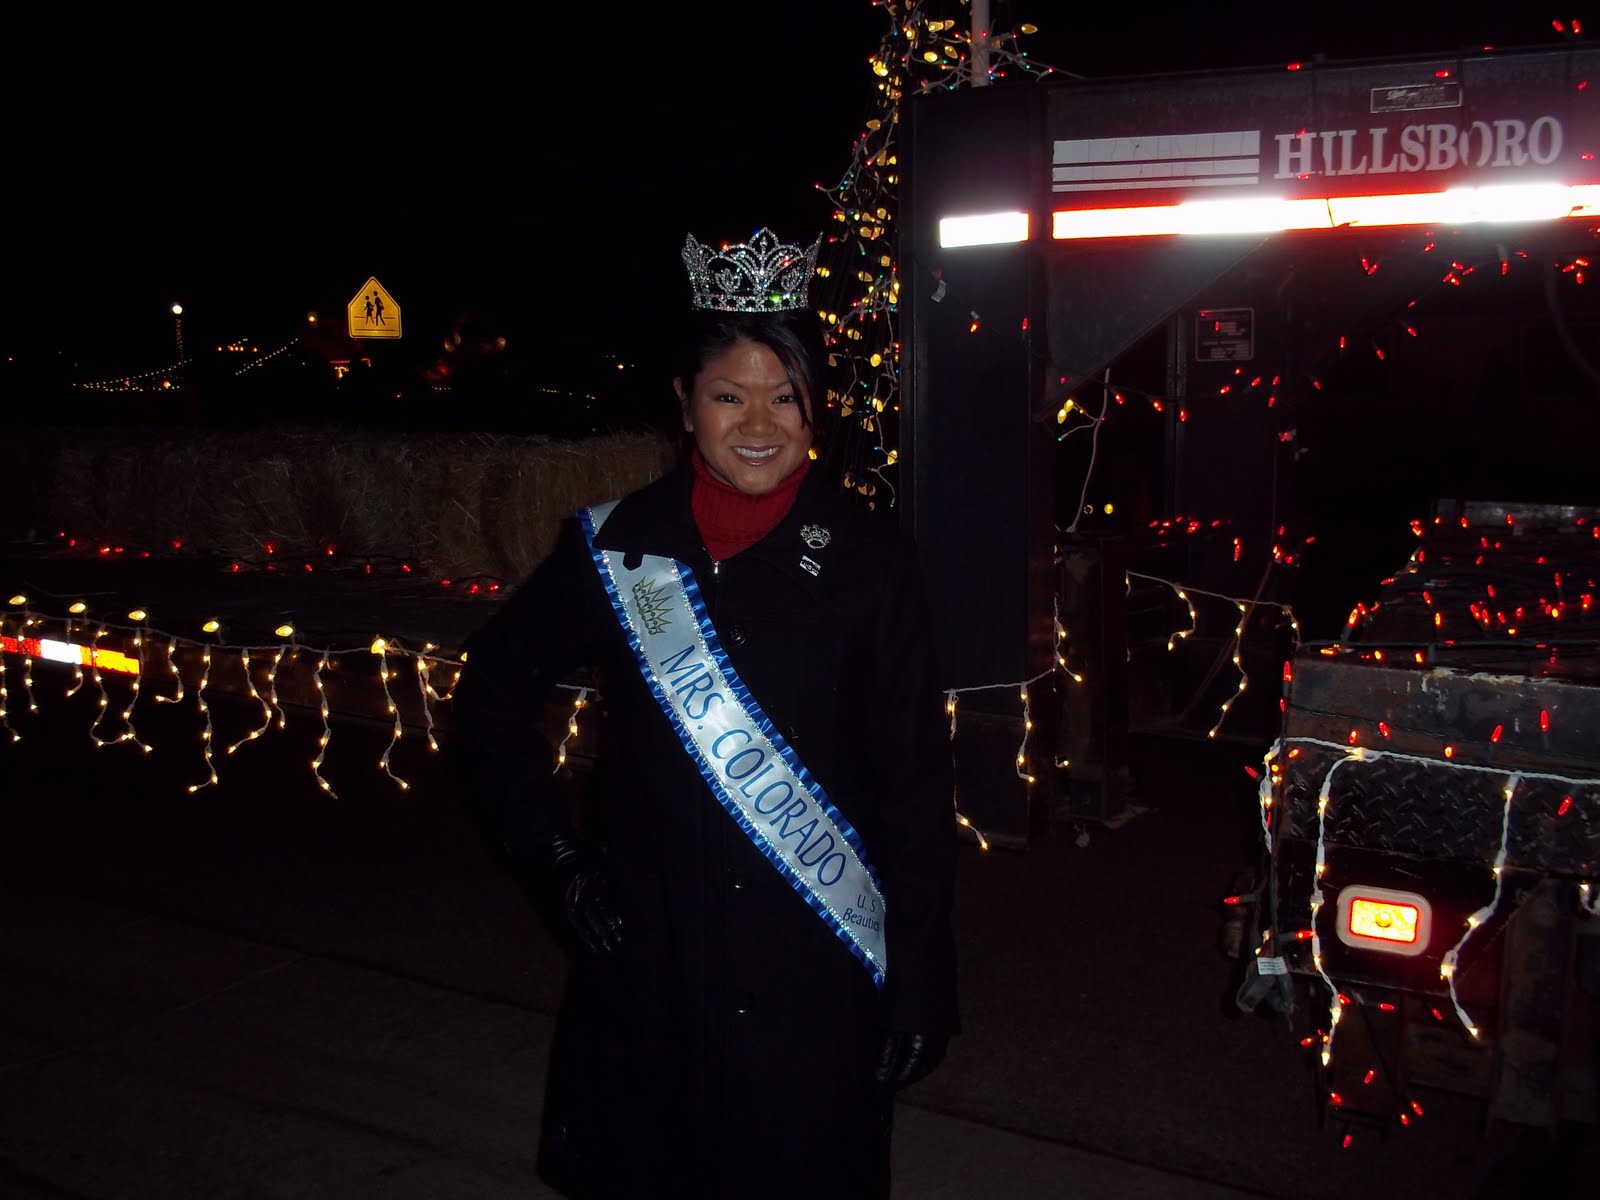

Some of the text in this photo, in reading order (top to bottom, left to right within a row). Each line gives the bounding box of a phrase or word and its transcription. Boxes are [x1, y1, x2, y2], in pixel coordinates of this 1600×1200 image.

[1274, 116, 1563, 179] HILLSBORO
[660, 645, 846, 886] MRS. COLORADO
